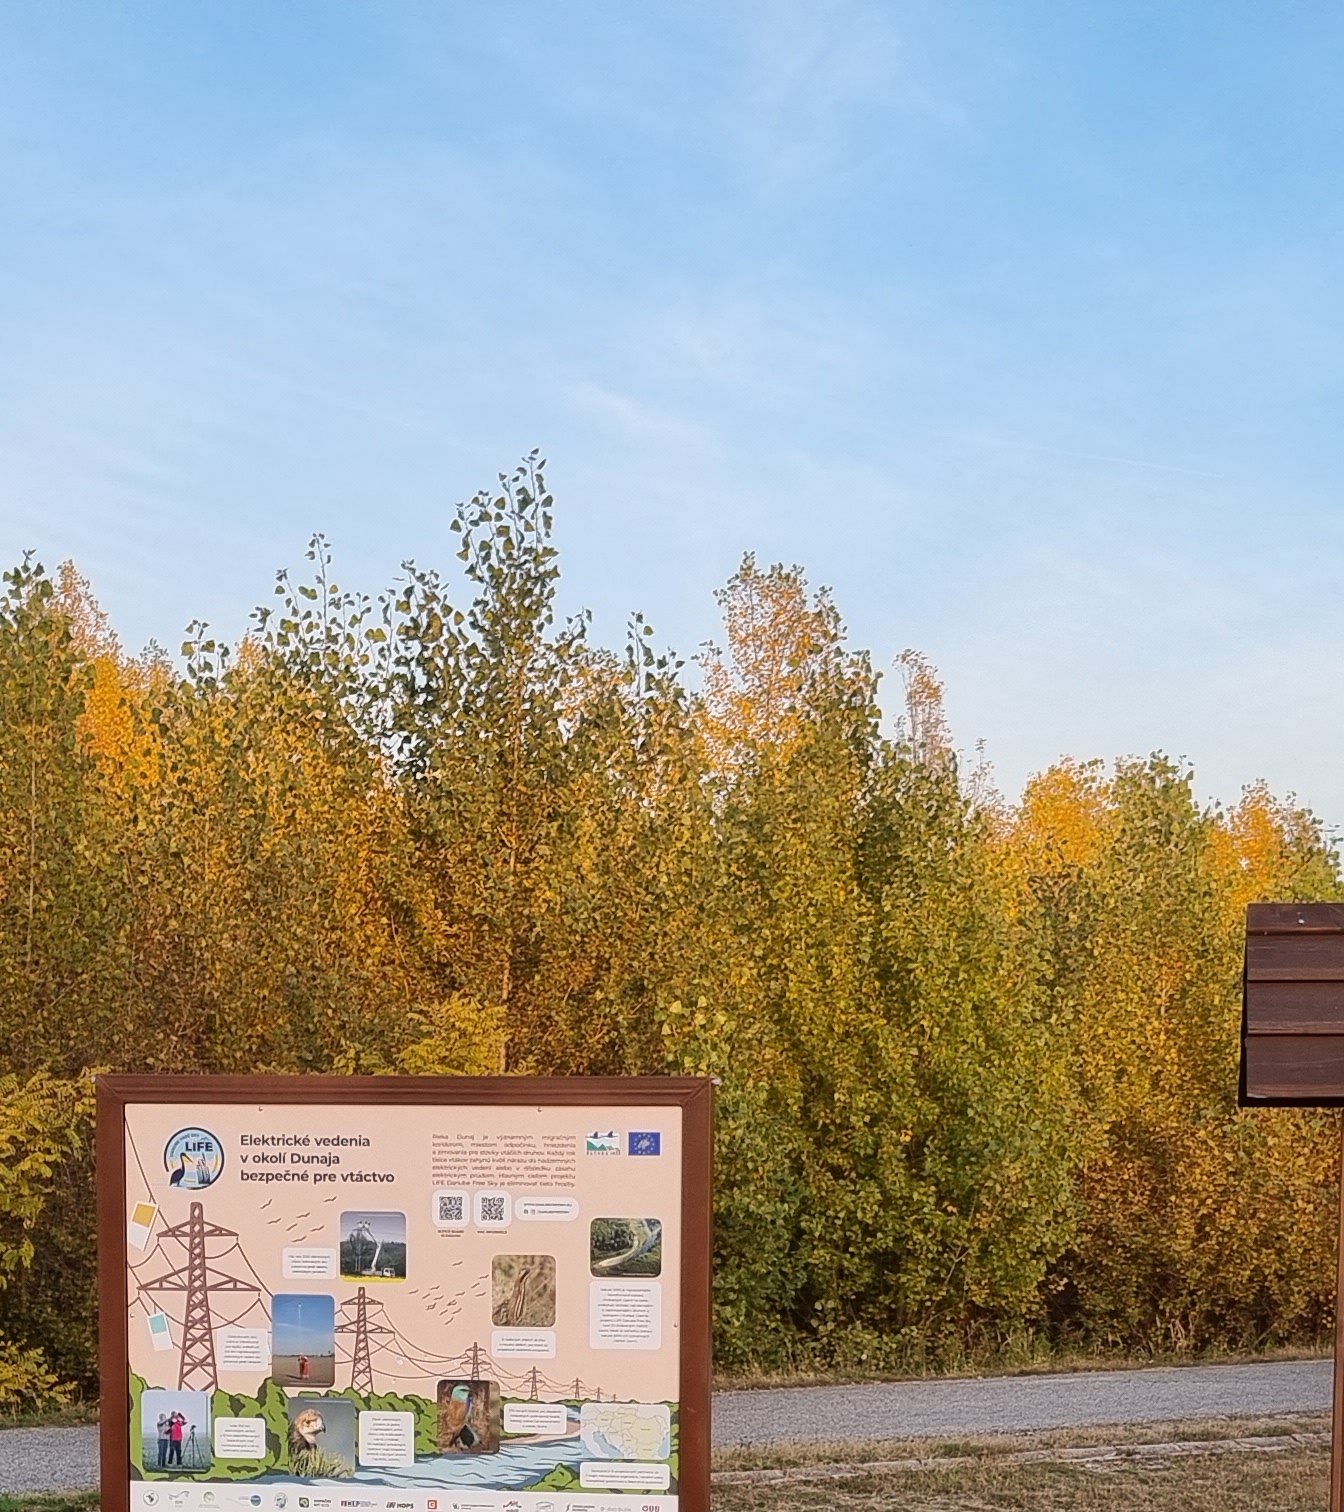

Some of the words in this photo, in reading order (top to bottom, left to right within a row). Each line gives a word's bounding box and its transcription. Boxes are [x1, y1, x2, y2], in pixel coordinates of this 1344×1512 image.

[185, 1141, 213, 1152] LIFE
[240, 1134, 311, 1147] Elektrické
[315, 1134, 370, 1147] vedenia
[252, 1152, 286, 1164] okolí
[290, 1152, 340, 1167] Dunaja
[240, 1170, 310, 1185] bezpečné
[313, 1171, 337, 1185] pre
[340, 1170, 395, 1183] vtáctvo
